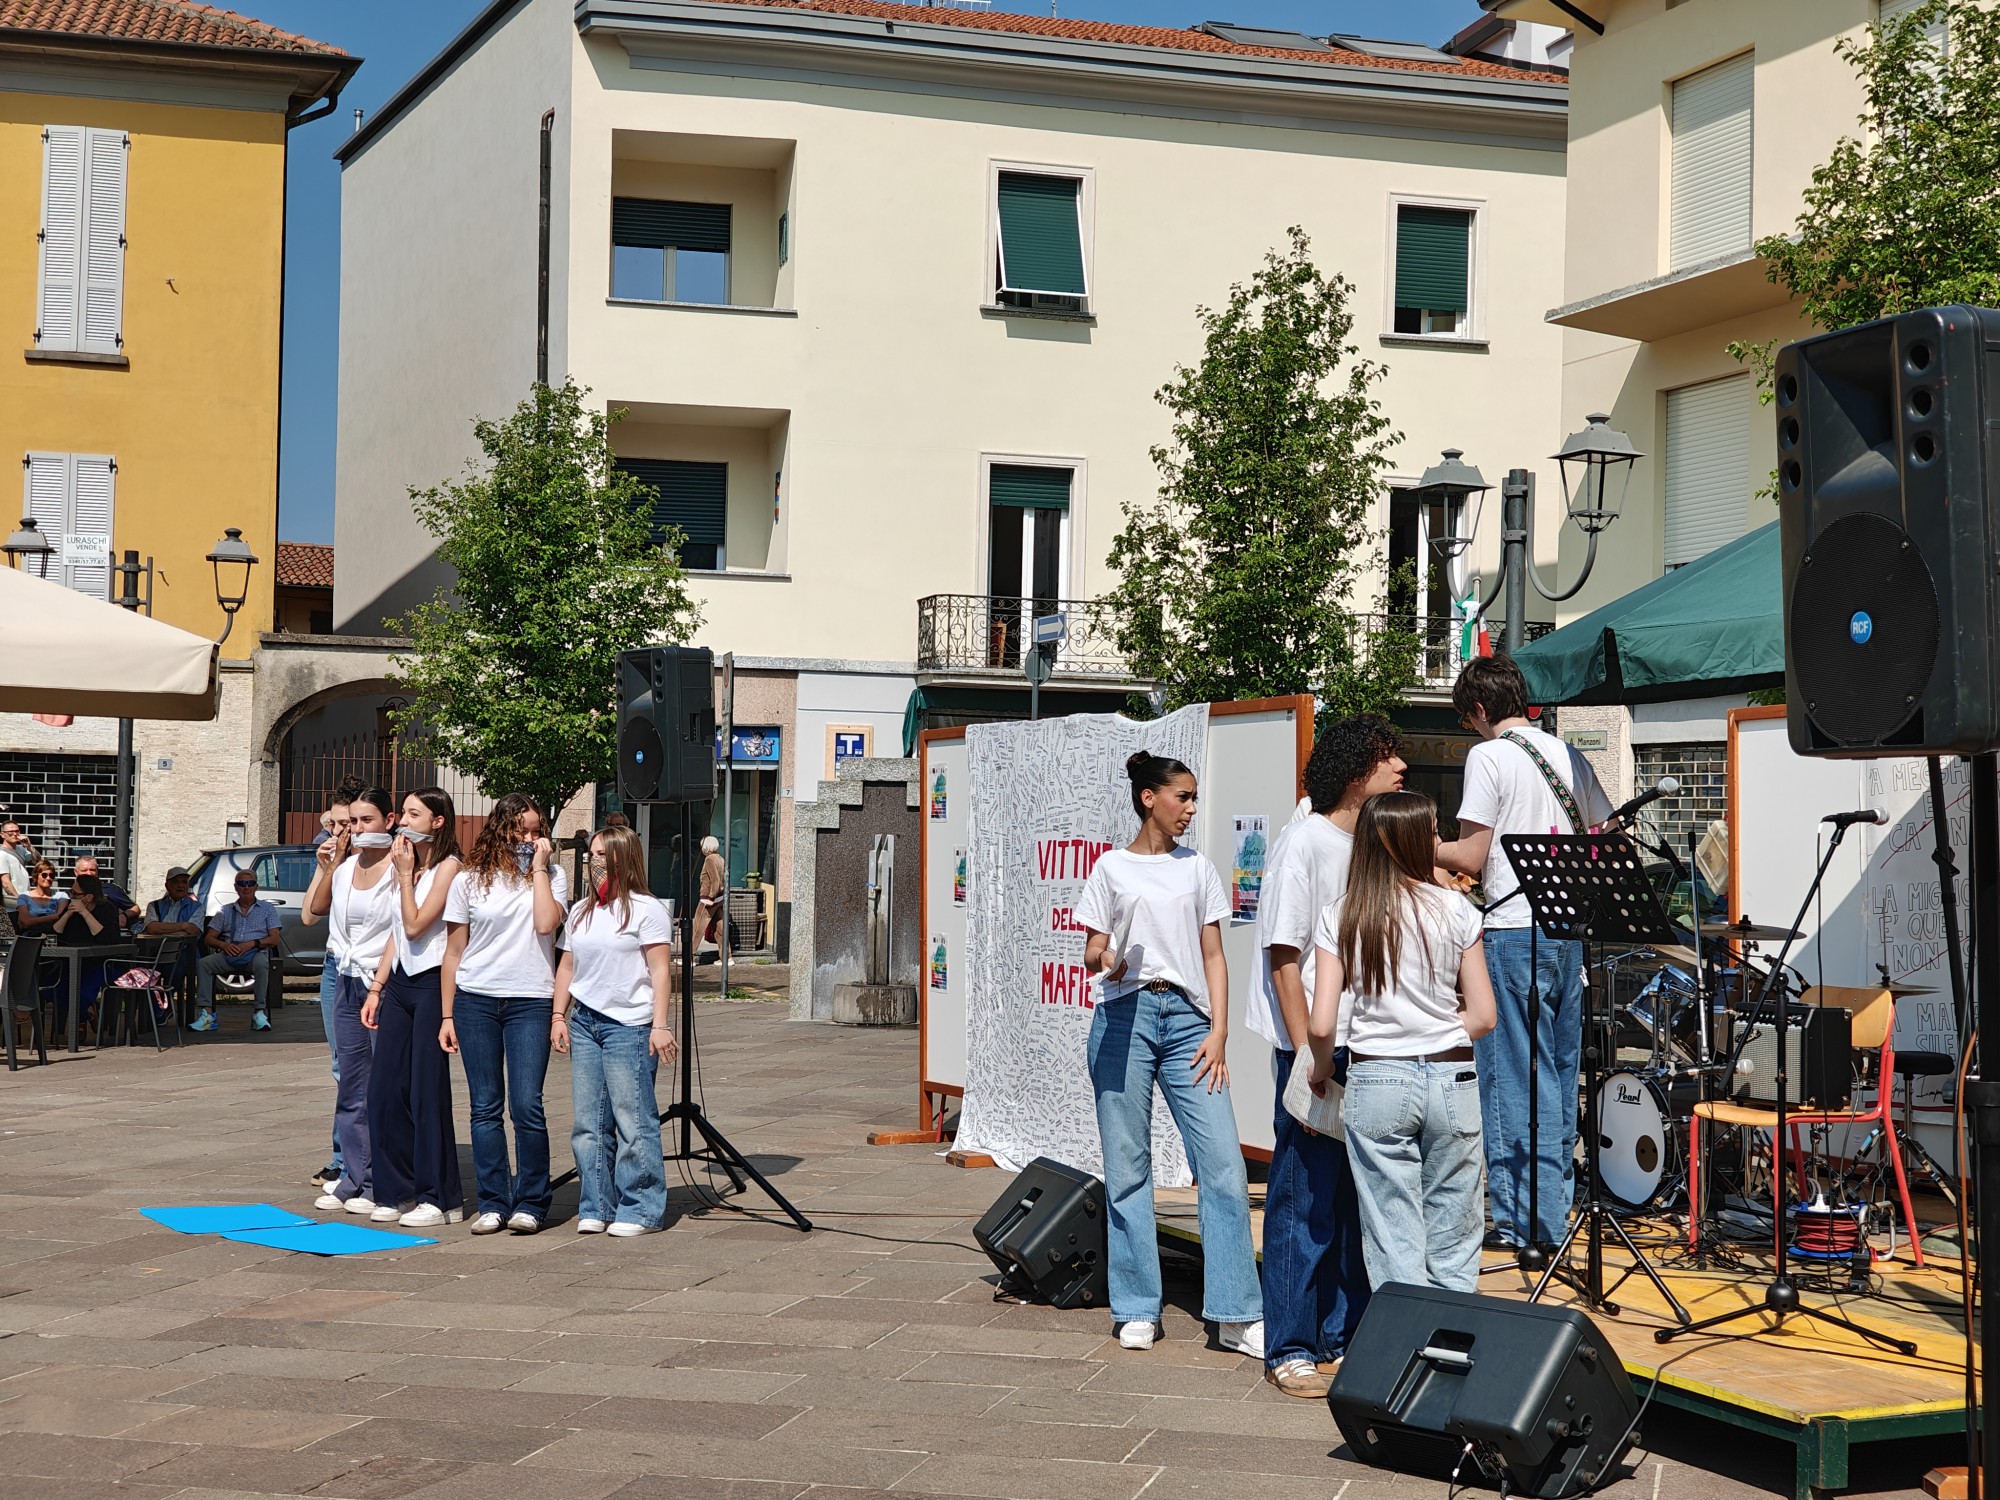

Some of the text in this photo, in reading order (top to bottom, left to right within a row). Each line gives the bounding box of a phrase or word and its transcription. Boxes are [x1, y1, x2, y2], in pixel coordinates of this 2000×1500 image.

[66, 536, 107, 545] LURASCHI
[1852, 620, 1869, 634] RCF
[1577, 737, 1602, 746] Manzoni
[1871, 883, 1898, 915] LA
[1892, 942, 1940, 973] NON
[1041, 961, 1096, 1010] MAFIE
[1612, 1082, 1642, 1103] Pearl
